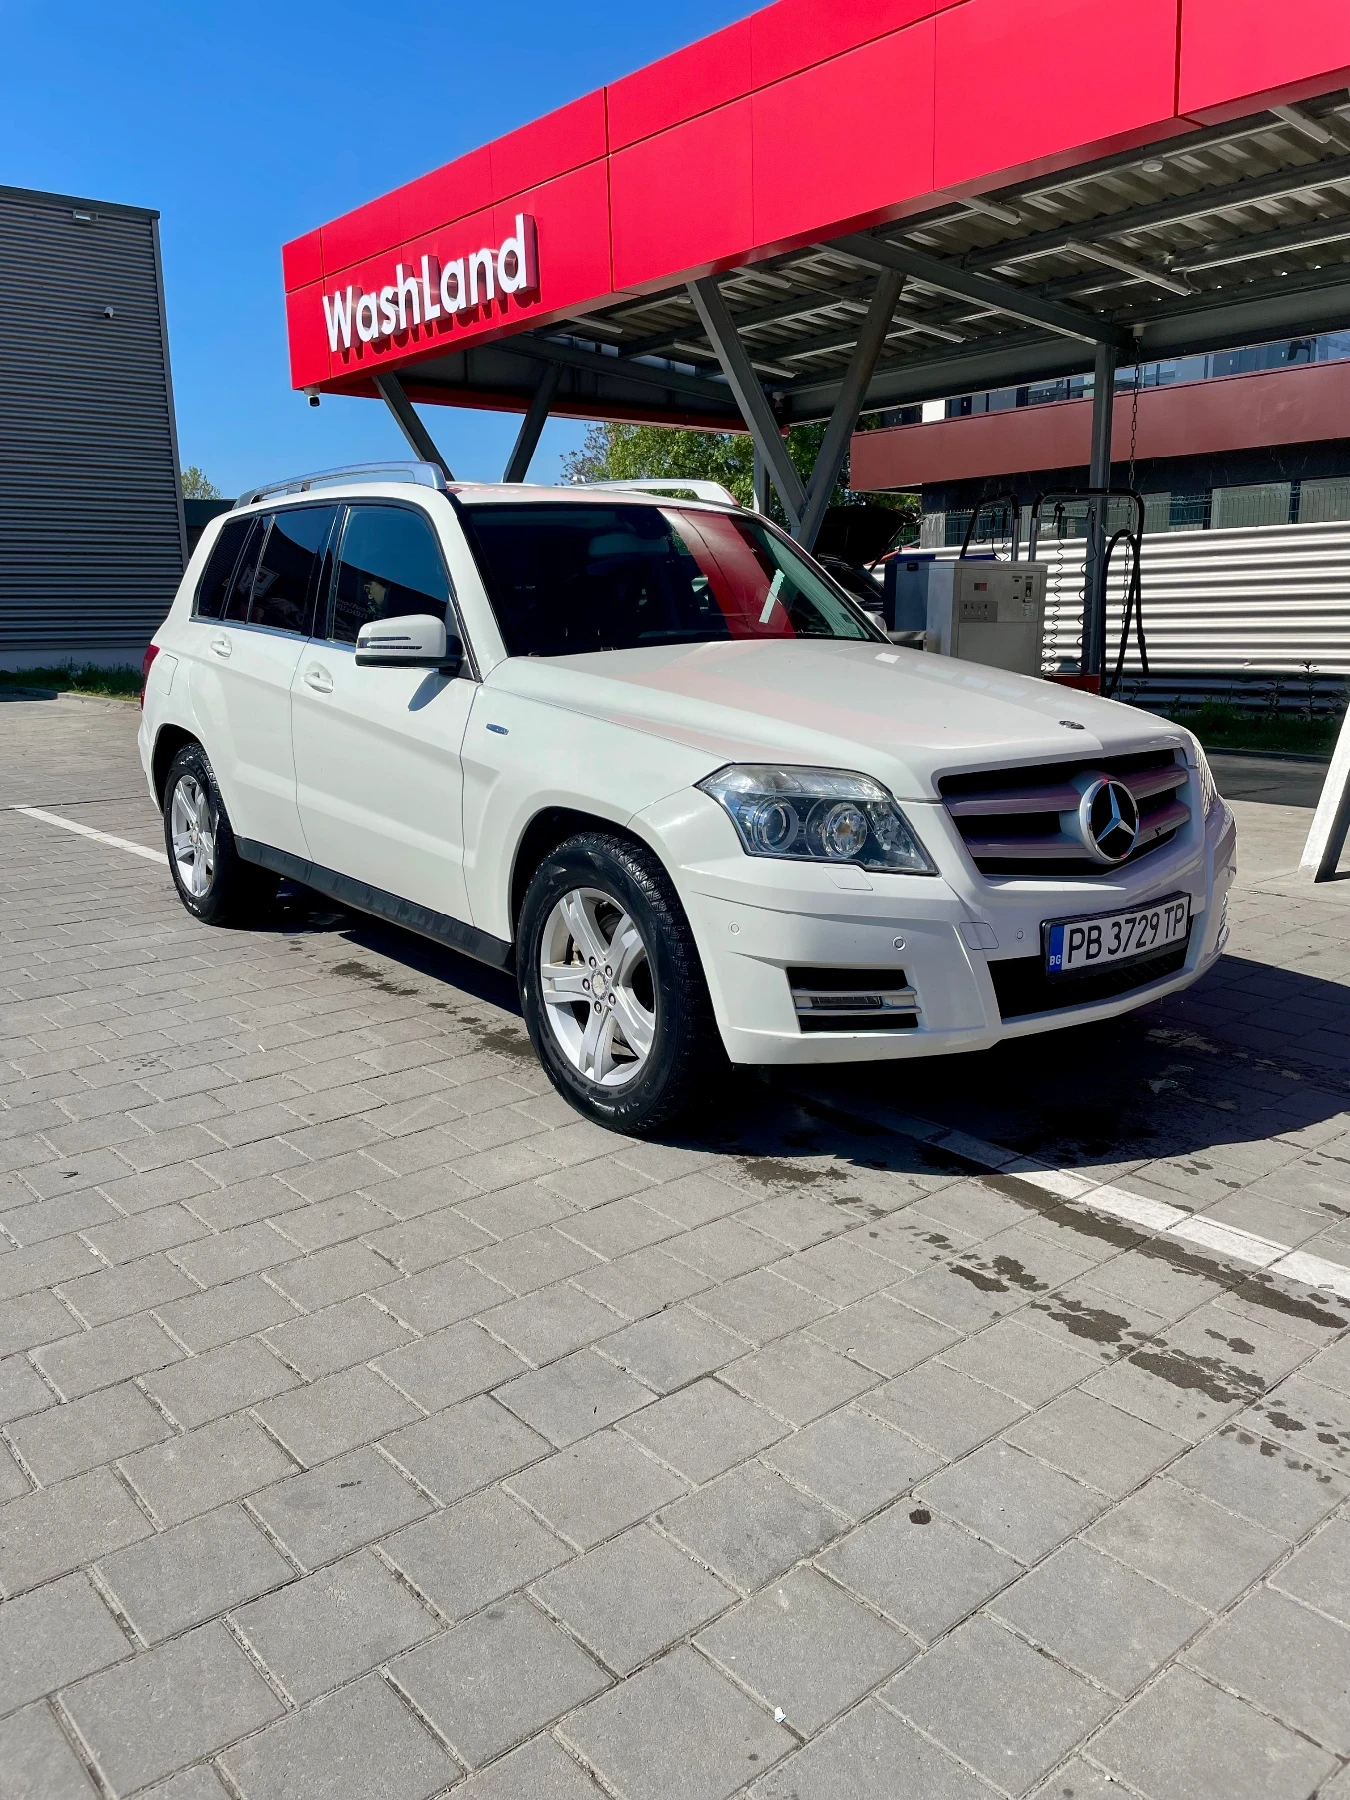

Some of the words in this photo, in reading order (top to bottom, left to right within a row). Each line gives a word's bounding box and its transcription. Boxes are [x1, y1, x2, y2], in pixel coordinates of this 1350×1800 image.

[322, 212, 529, 353] WashLand
[1049, 954, 1062, 966] BG
[1067, 925, 1102, 963] PB
[1107, 912, 1160, 955] 3729
[1164, 903, 1185, 938] TP
